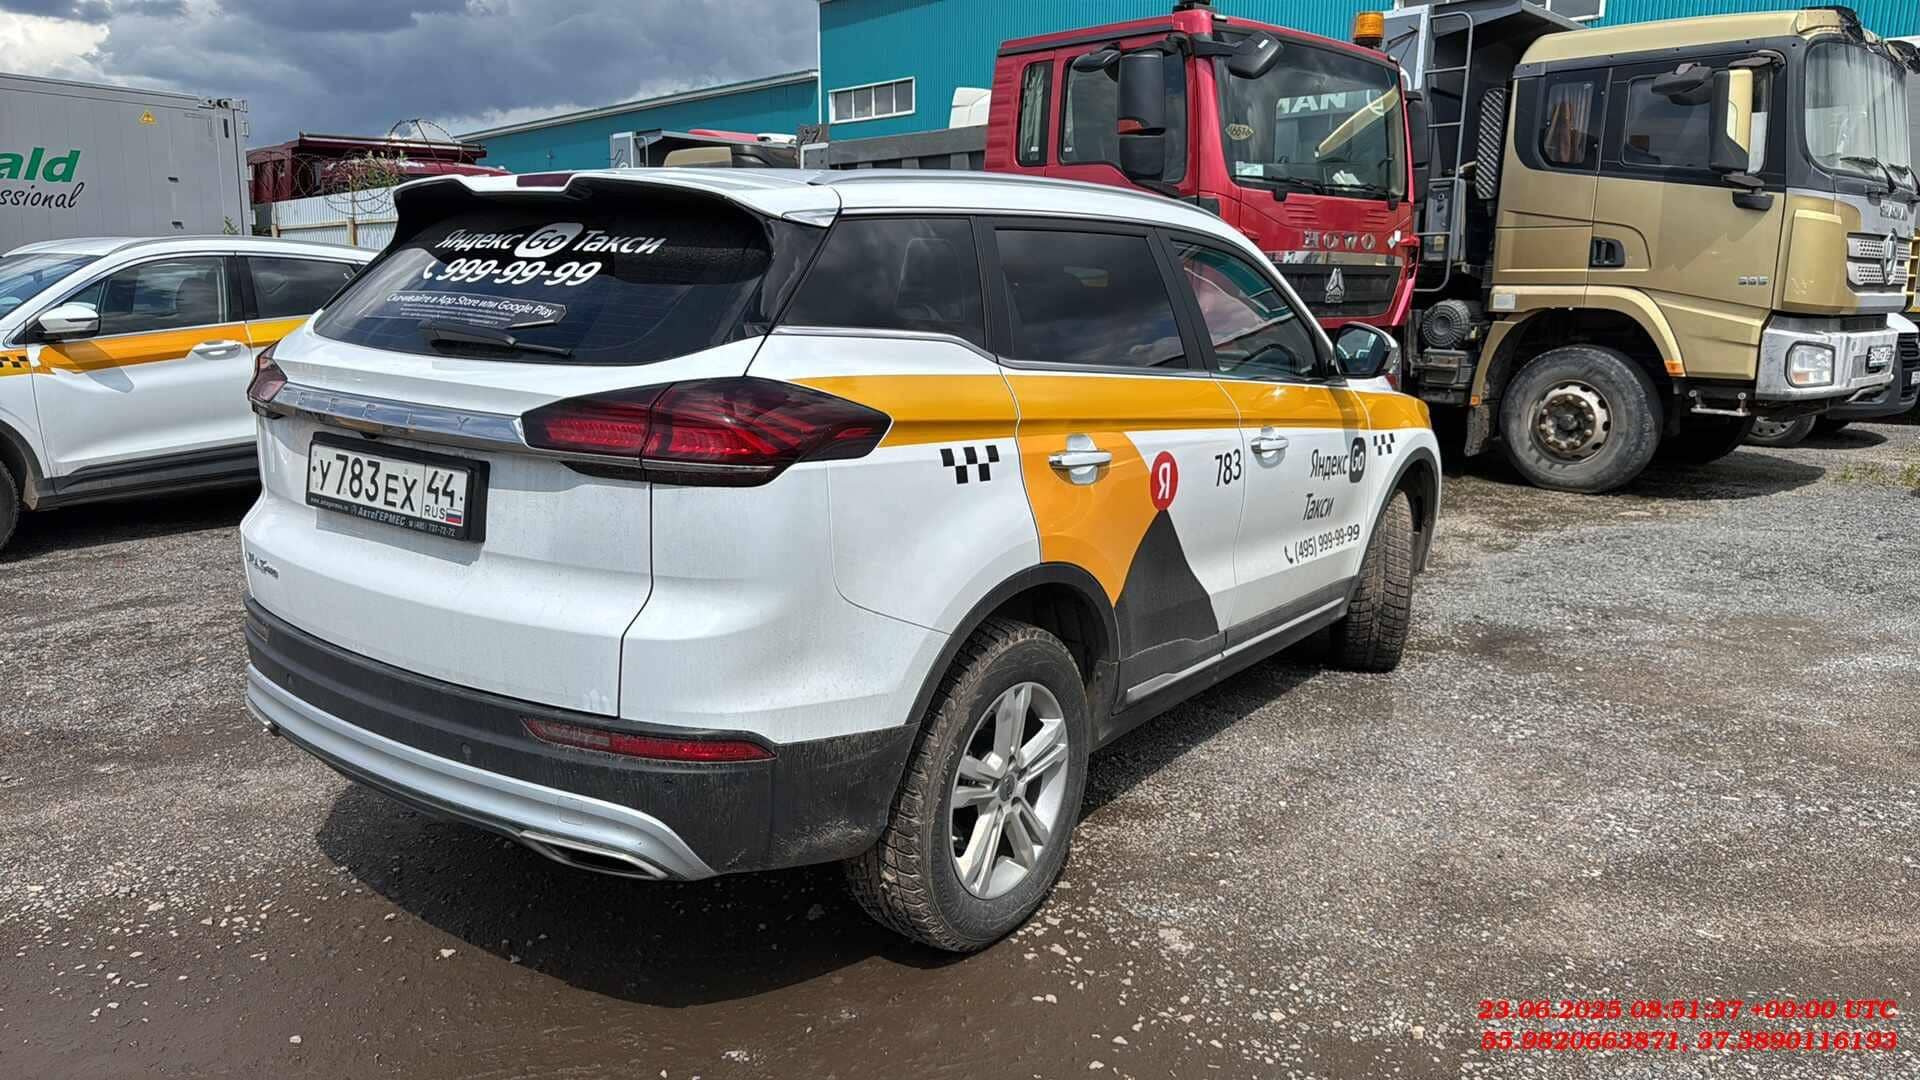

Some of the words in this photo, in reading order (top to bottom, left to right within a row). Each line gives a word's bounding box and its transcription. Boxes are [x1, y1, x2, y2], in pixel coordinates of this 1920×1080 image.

[435, 228, 524, 251] Яндекс
[572, 230, 667, 254] Такси
[1303, 230, 1377, 250] HOWO
[435, 258, 602, 286] 999-99-99
[435, 295, 456, 305] App
[456, 295, 480, 308] Store
[498, 300, 532, 315] Google
[532, 303, 557, 318] Play
[1214, 448, 1243, 488] 783
[1309, 448, 1348, 480] Яндекс
[427, 470, 457, 507] 44
[1157, 463, 1171, 500] Я
[423, 504, 446, 519] RUS
[1302, 493, 1335, 521] Такси
[1295, 535, 1317, 564] (495)
[1318, 523, 1360, 553] 999-99-99
